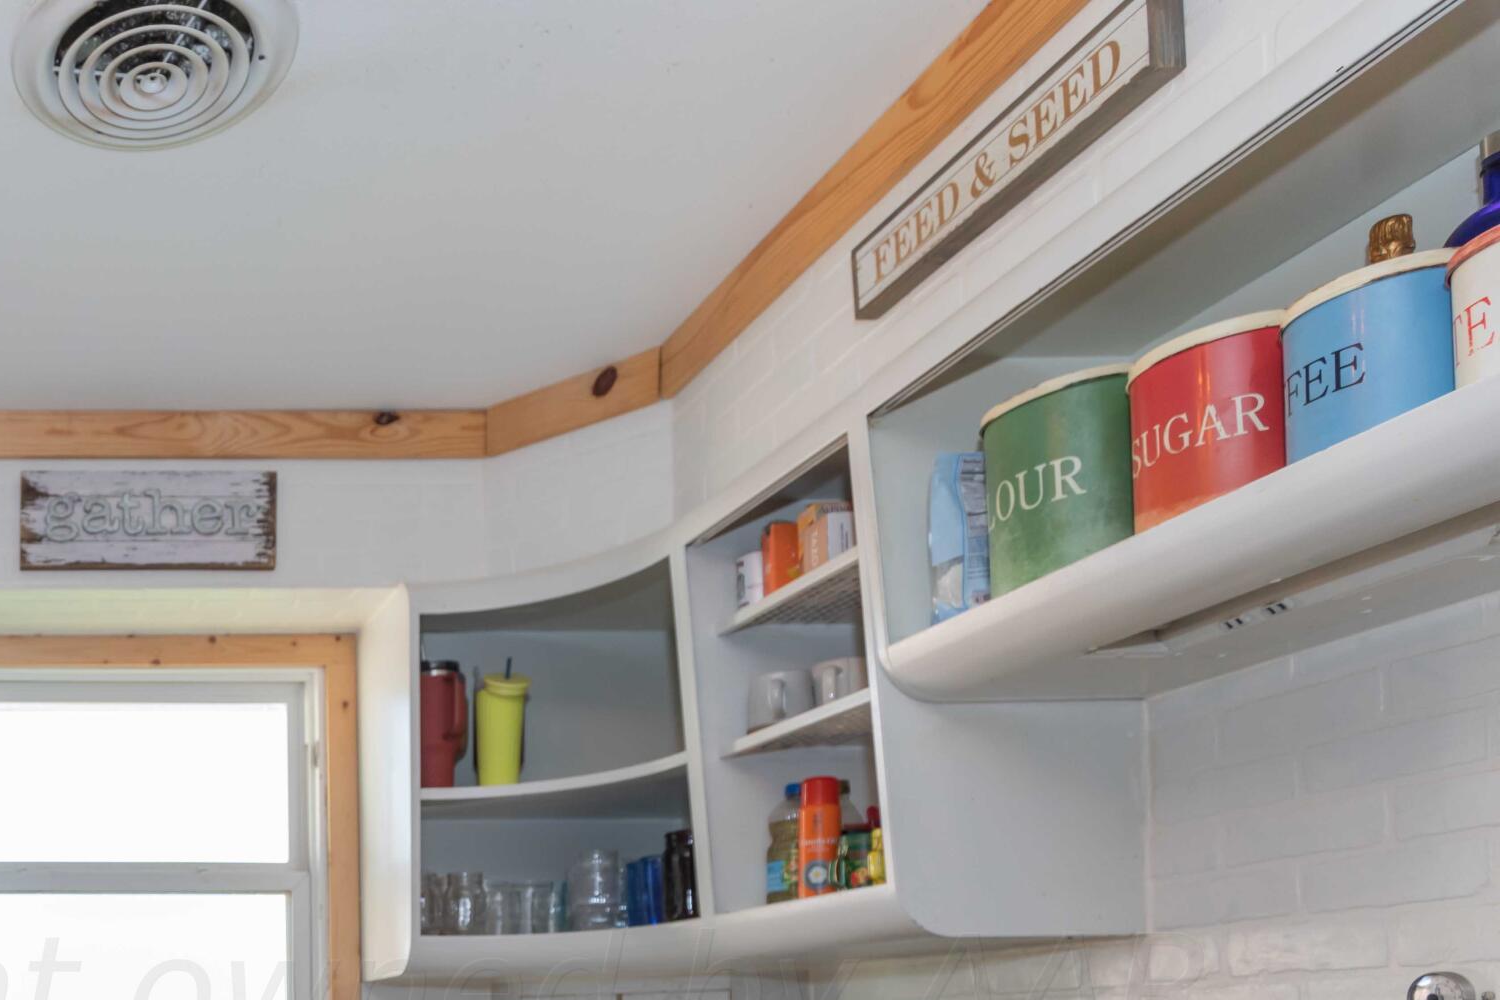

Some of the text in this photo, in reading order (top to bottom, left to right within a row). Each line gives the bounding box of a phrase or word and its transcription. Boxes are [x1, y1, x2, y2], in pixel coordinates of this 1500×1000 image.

[871, 40, 1121, 285] FEED & SEED
[1132, 393, 1269, 478] SUGAR
[45, 488, 264, 543] gather
